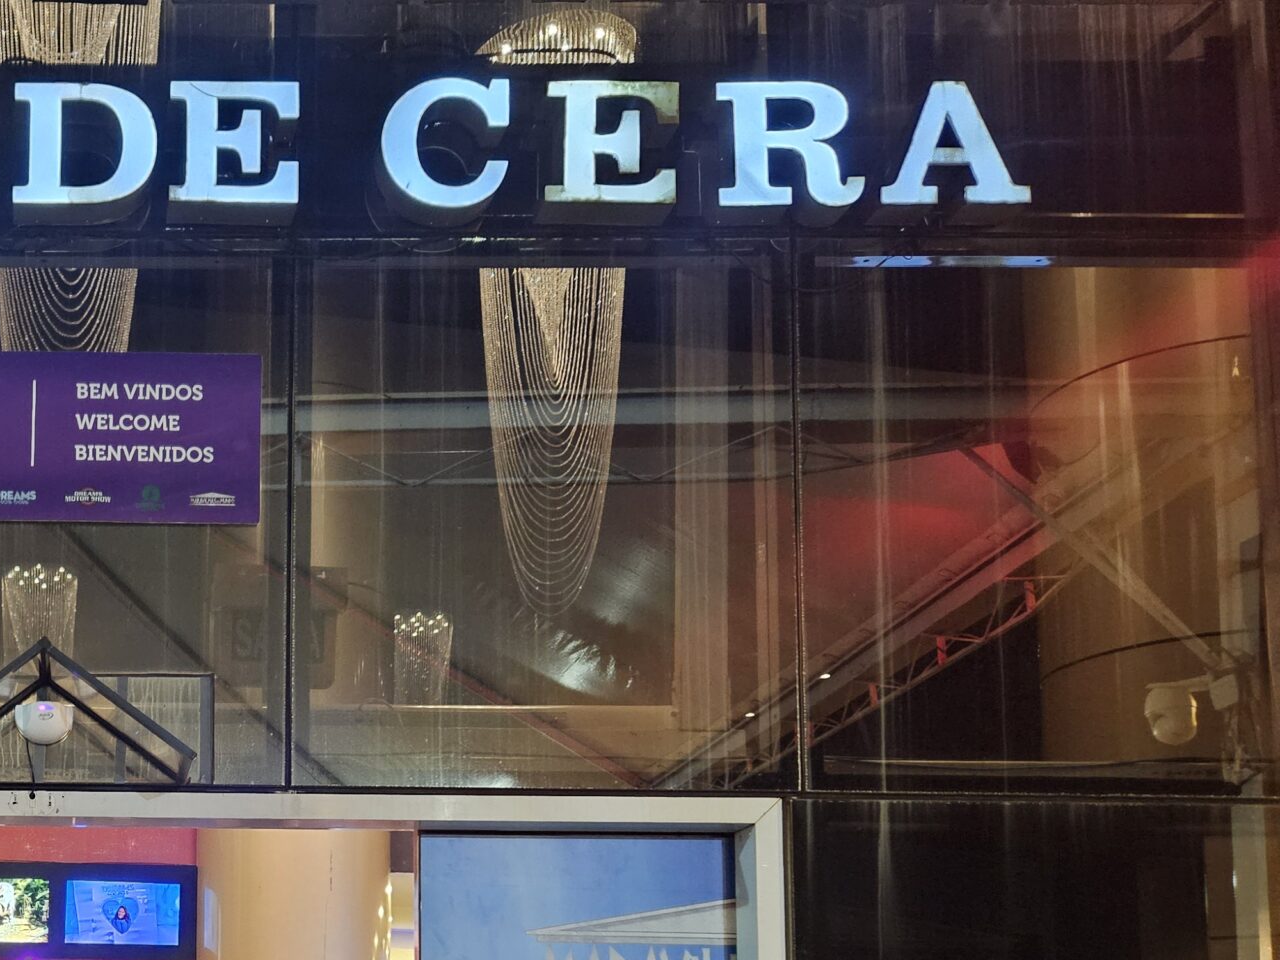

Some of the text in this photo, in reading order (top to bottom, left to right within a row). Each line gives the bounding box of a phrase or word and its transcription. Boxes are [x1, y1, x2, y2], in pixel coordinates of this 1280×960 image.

[11, 79, 302, 207] DE
[380, 76, 1033, 211] CERA
[75, 383, 204, 402] BEM VINDOS
[75, 413, 180, 432] WELCOME
[74, 444, 215, 464] BIENVENIDOS
